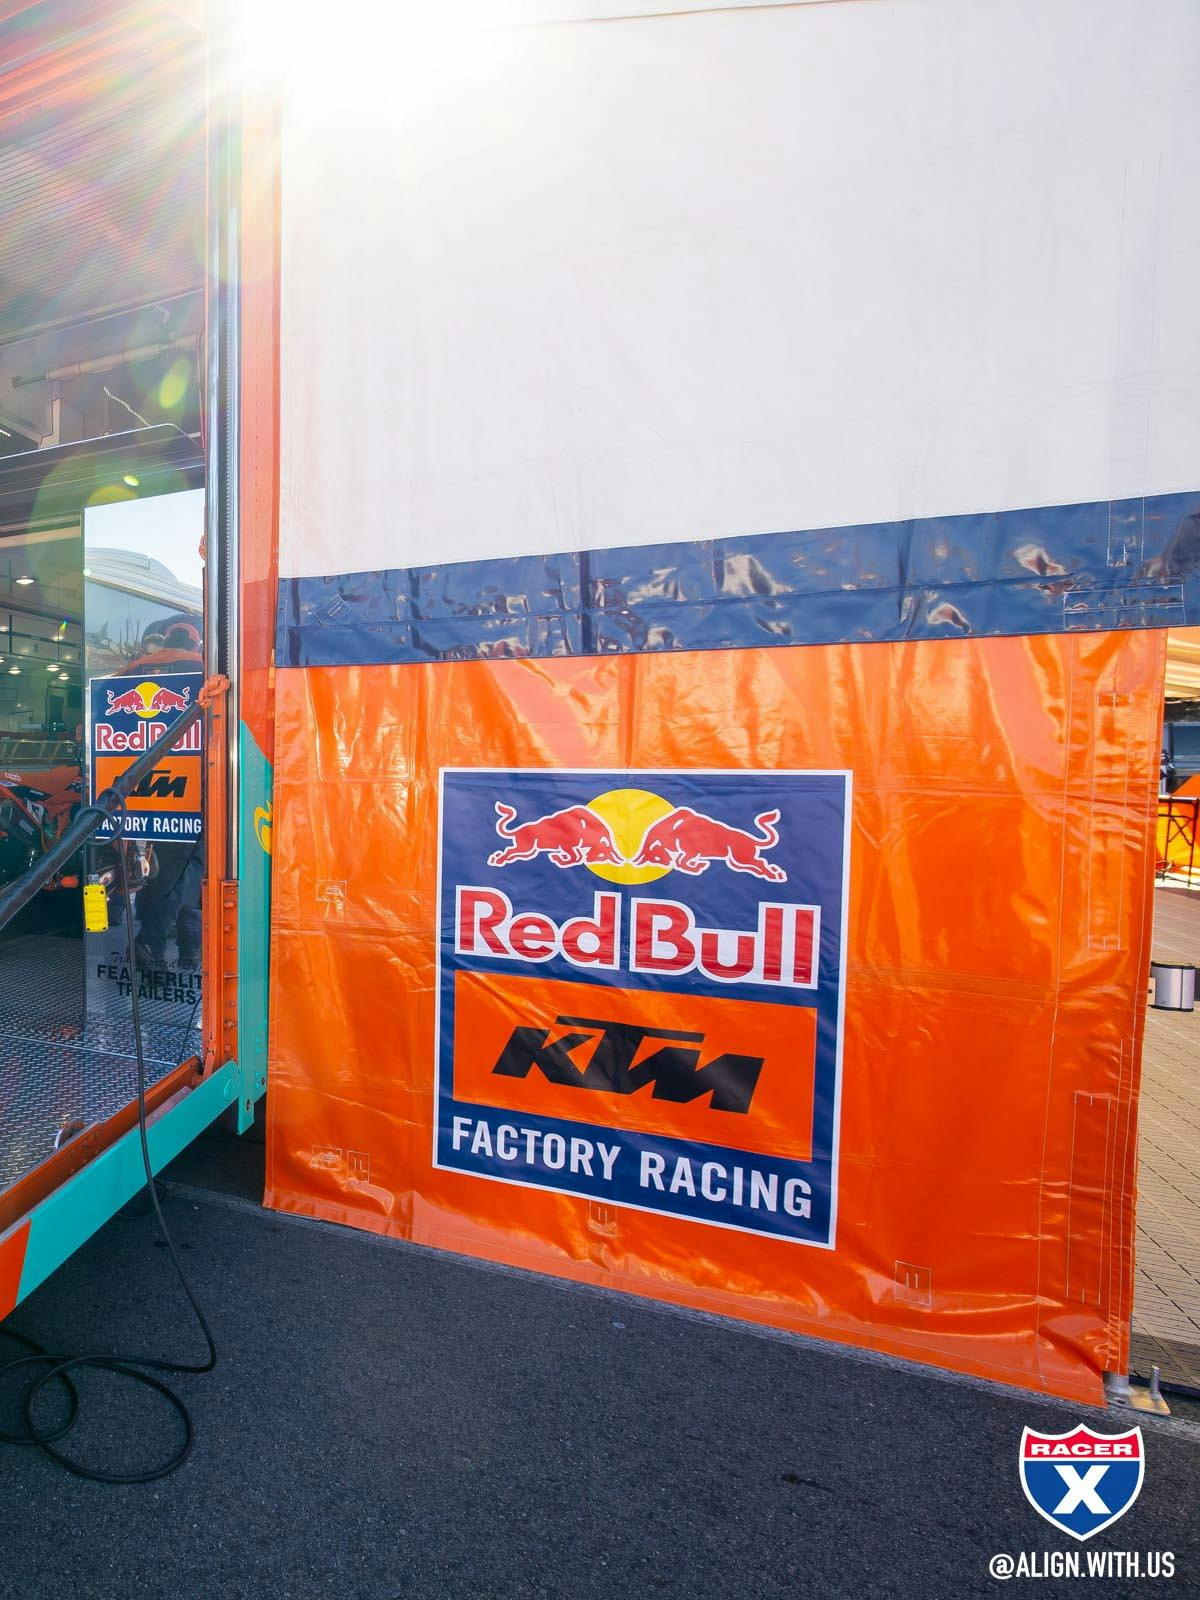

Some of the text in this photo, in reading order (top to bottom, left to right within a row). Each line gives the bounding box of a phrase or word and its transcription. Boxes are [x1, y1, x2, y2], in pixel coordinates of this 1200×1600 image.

[95, 721, 146, 751] Red
[153, 817, 202, 834] RACING
[455, 885, 821, 989] Red Bull
[492, 1015, 765, 1114] KTM
[452, 1115, 813, 1219] FACTORY RACING
